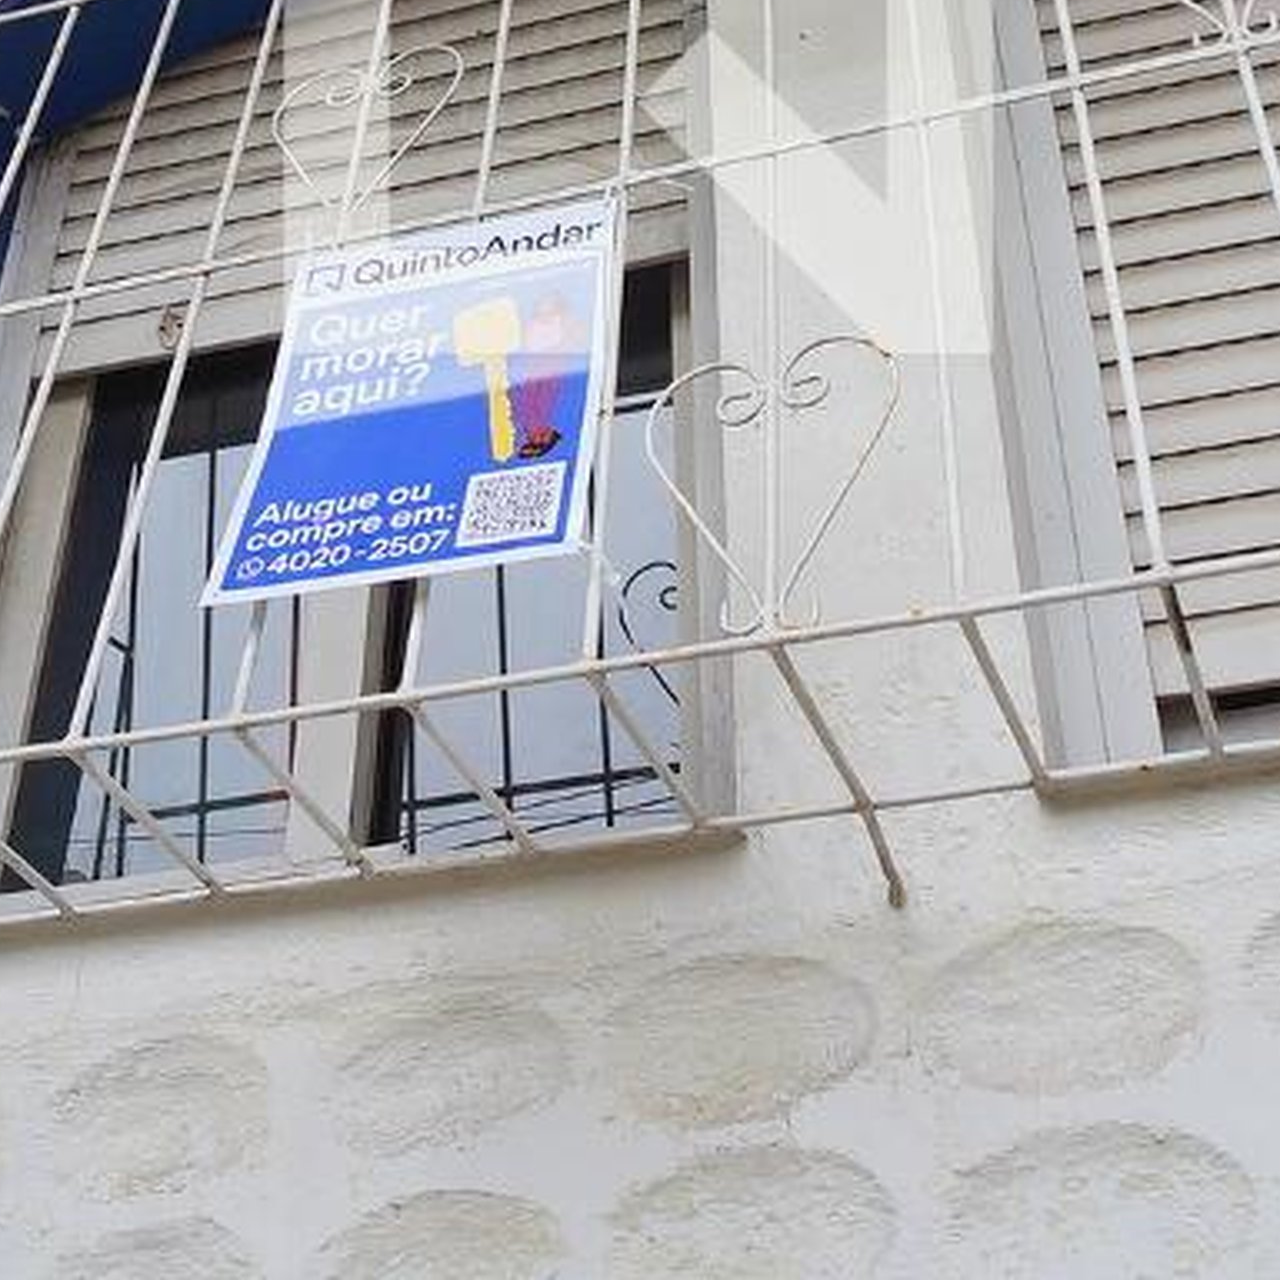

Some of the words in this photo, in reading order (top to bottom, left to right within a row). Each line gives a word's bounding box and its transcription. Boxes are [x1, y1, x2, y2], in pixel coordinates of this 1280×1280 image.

[353, 221, 604, 286] QuintoAndar
[309, 304, 430, 348] Quer
[298, 329, 447, 383] morar
[292, 362, 432, 416] aqui?
[245, 516, 383, 552] compre
[389, 502, 458, 529] em:
[252, 491, 380, 528] Alugue
[387, 482, 432, 506] ou
